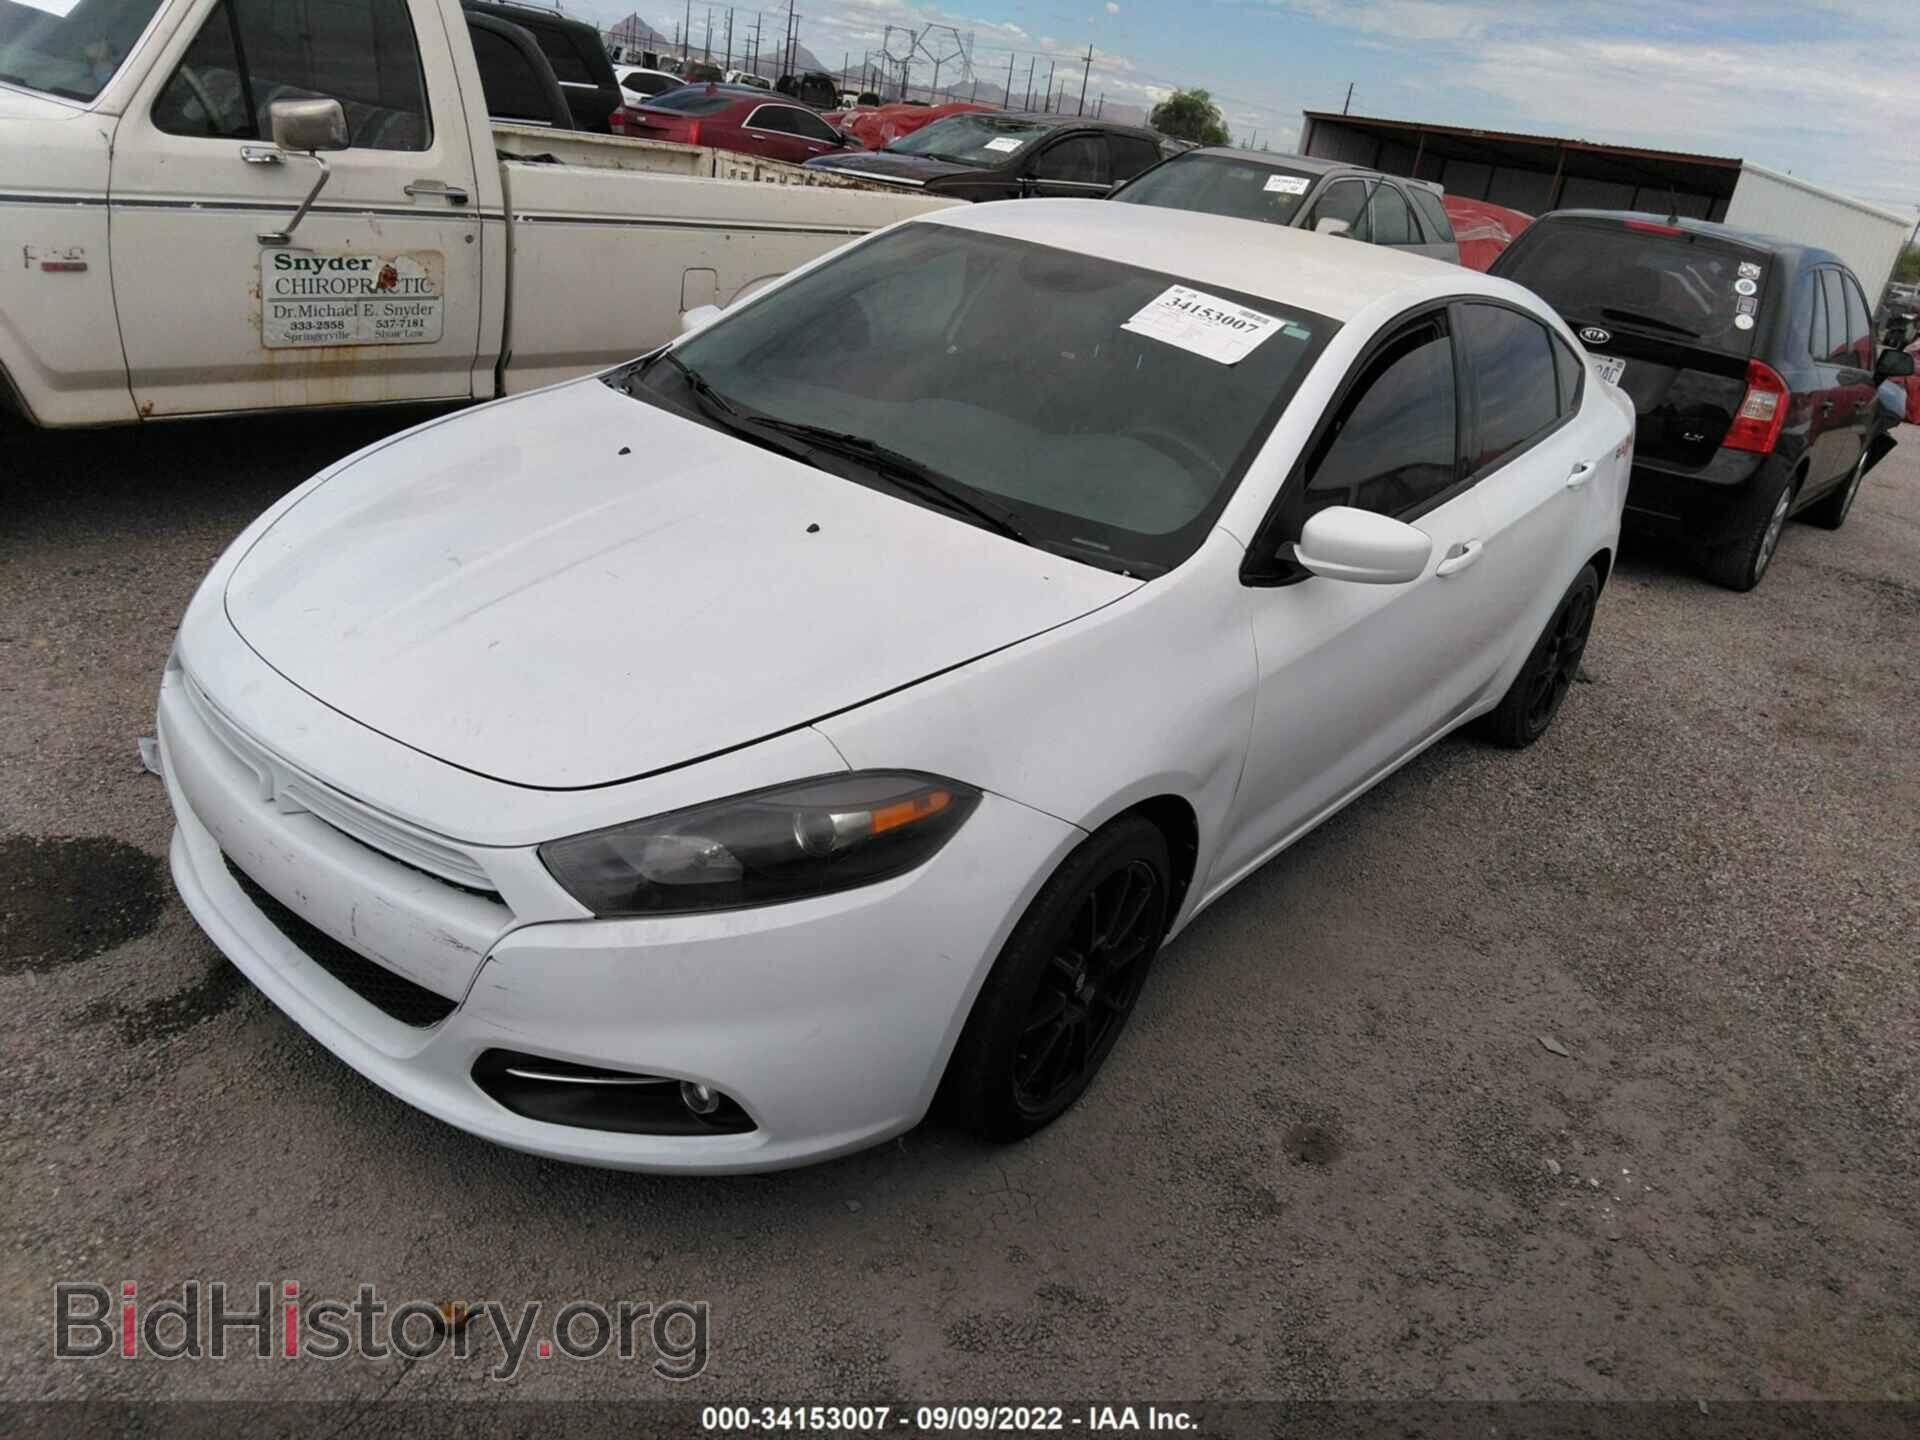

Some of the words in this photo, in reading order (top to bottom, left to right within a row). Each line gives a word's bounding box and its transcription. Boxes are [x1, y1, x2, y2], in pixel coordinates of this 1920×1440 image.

[274, 253, 372, 275] Snyder
[363, 305, 379, 317] E.
[383, 303, 434, 318] Snyder
[1165, 297, 1259, 334] 34153007
[375, 319, 424, 329] 537-7181
[1584, 330, 1607, 341] KIA
